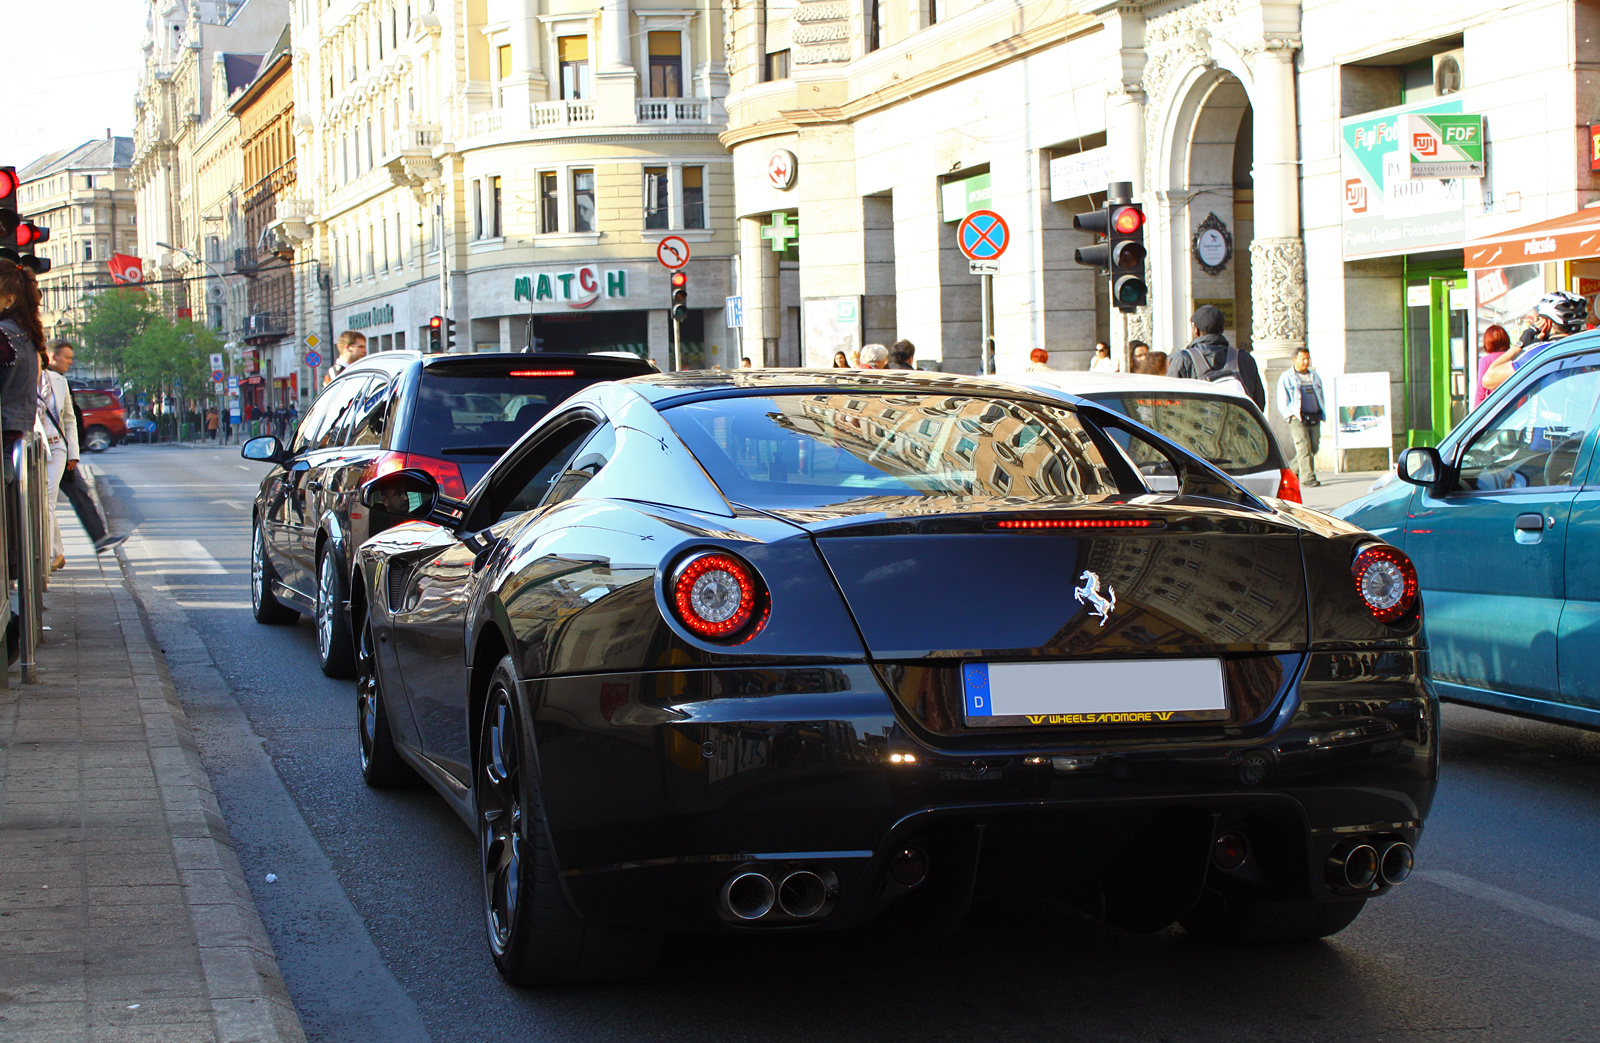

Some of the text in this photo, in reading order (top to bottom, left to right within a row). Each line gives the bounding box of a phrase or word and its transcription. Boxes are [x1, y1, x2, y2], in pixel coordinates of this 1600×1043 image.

[1354, 121, 1398, 152] FujiFot
[1445, 126, 1476, 142] FDF
[1413, 135, 1436, 153] FUJI
[1524, 236, 1556, 255] PÉKSÉG
[514, 268, 626, 302] MATCH
[974, 696, 984, 708] D
